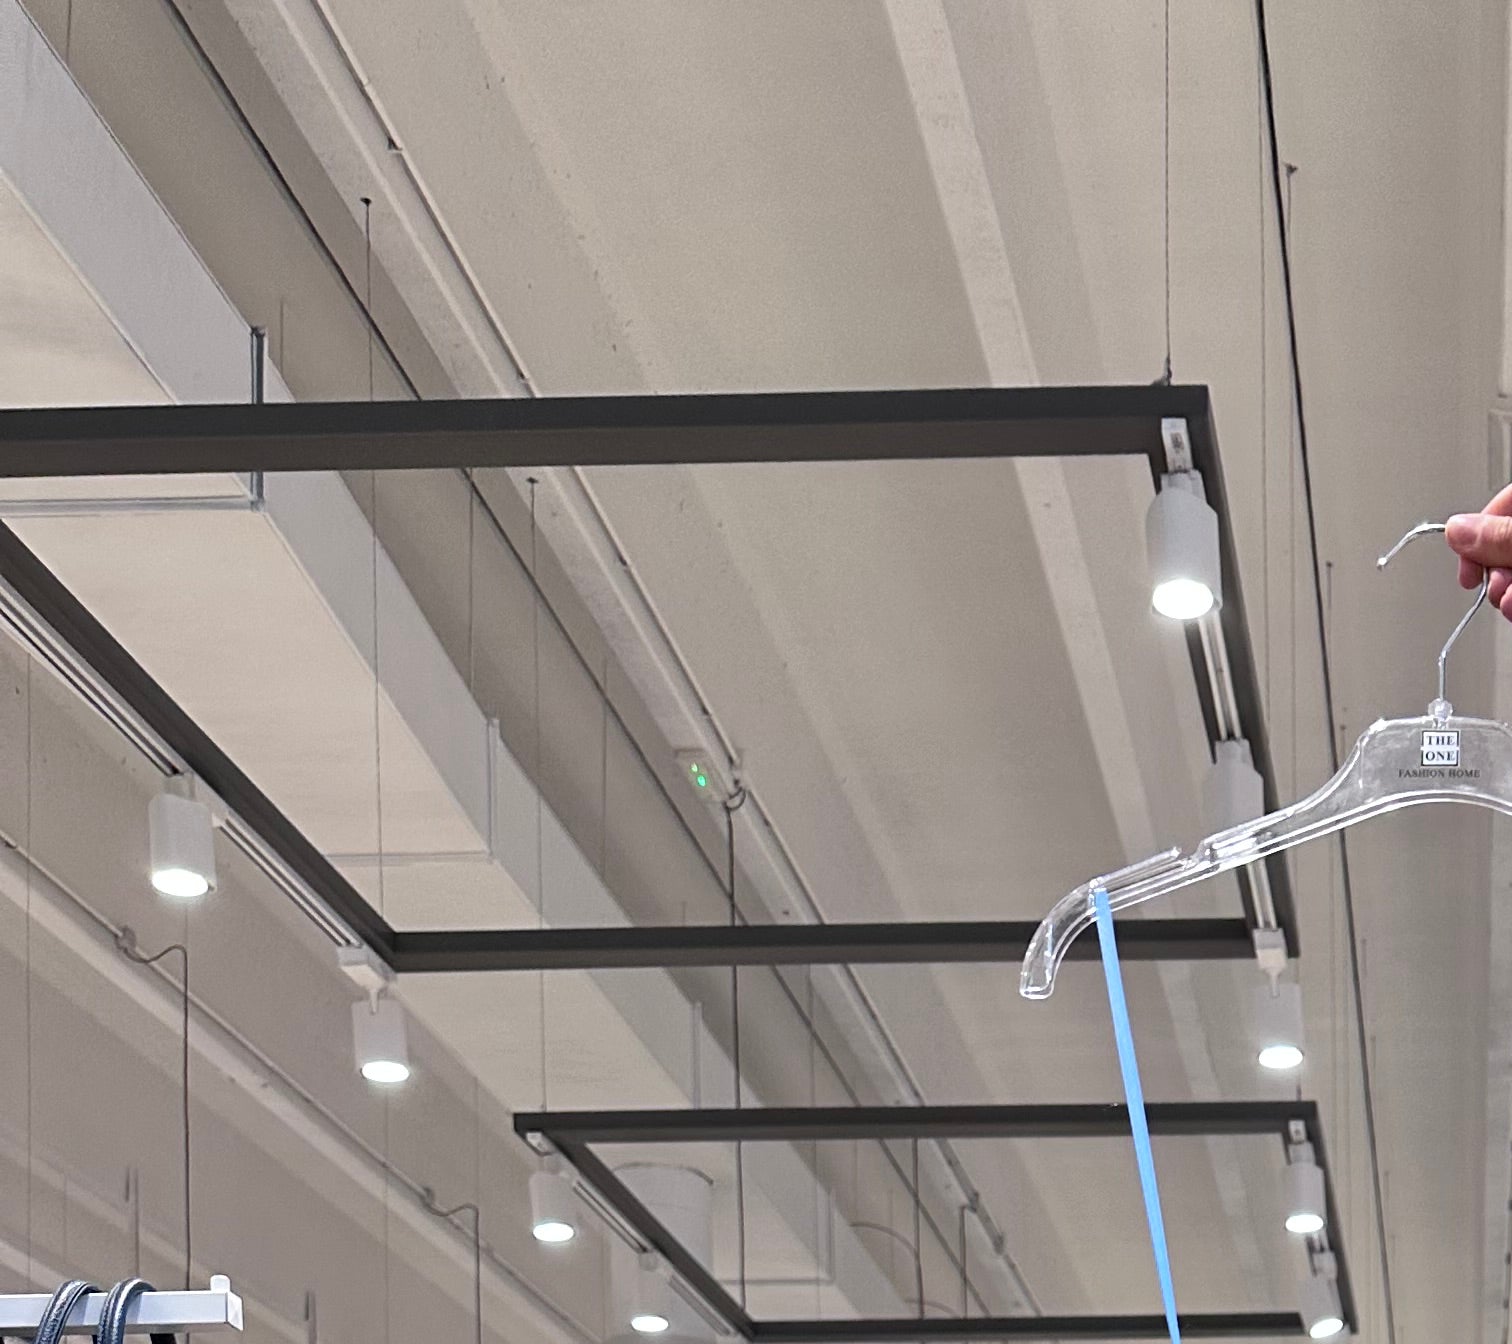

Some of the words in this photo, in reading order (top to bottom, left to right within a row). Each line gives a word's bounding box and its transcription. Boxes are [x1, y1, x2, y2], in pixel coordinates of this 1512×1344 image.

[1426, 735, 1455, 746] THE
[1425, 750, 1455, 762] ONE
[1398, 768, 1445, 779] FASHION
[1448, 768, 1481, 779] HOME
